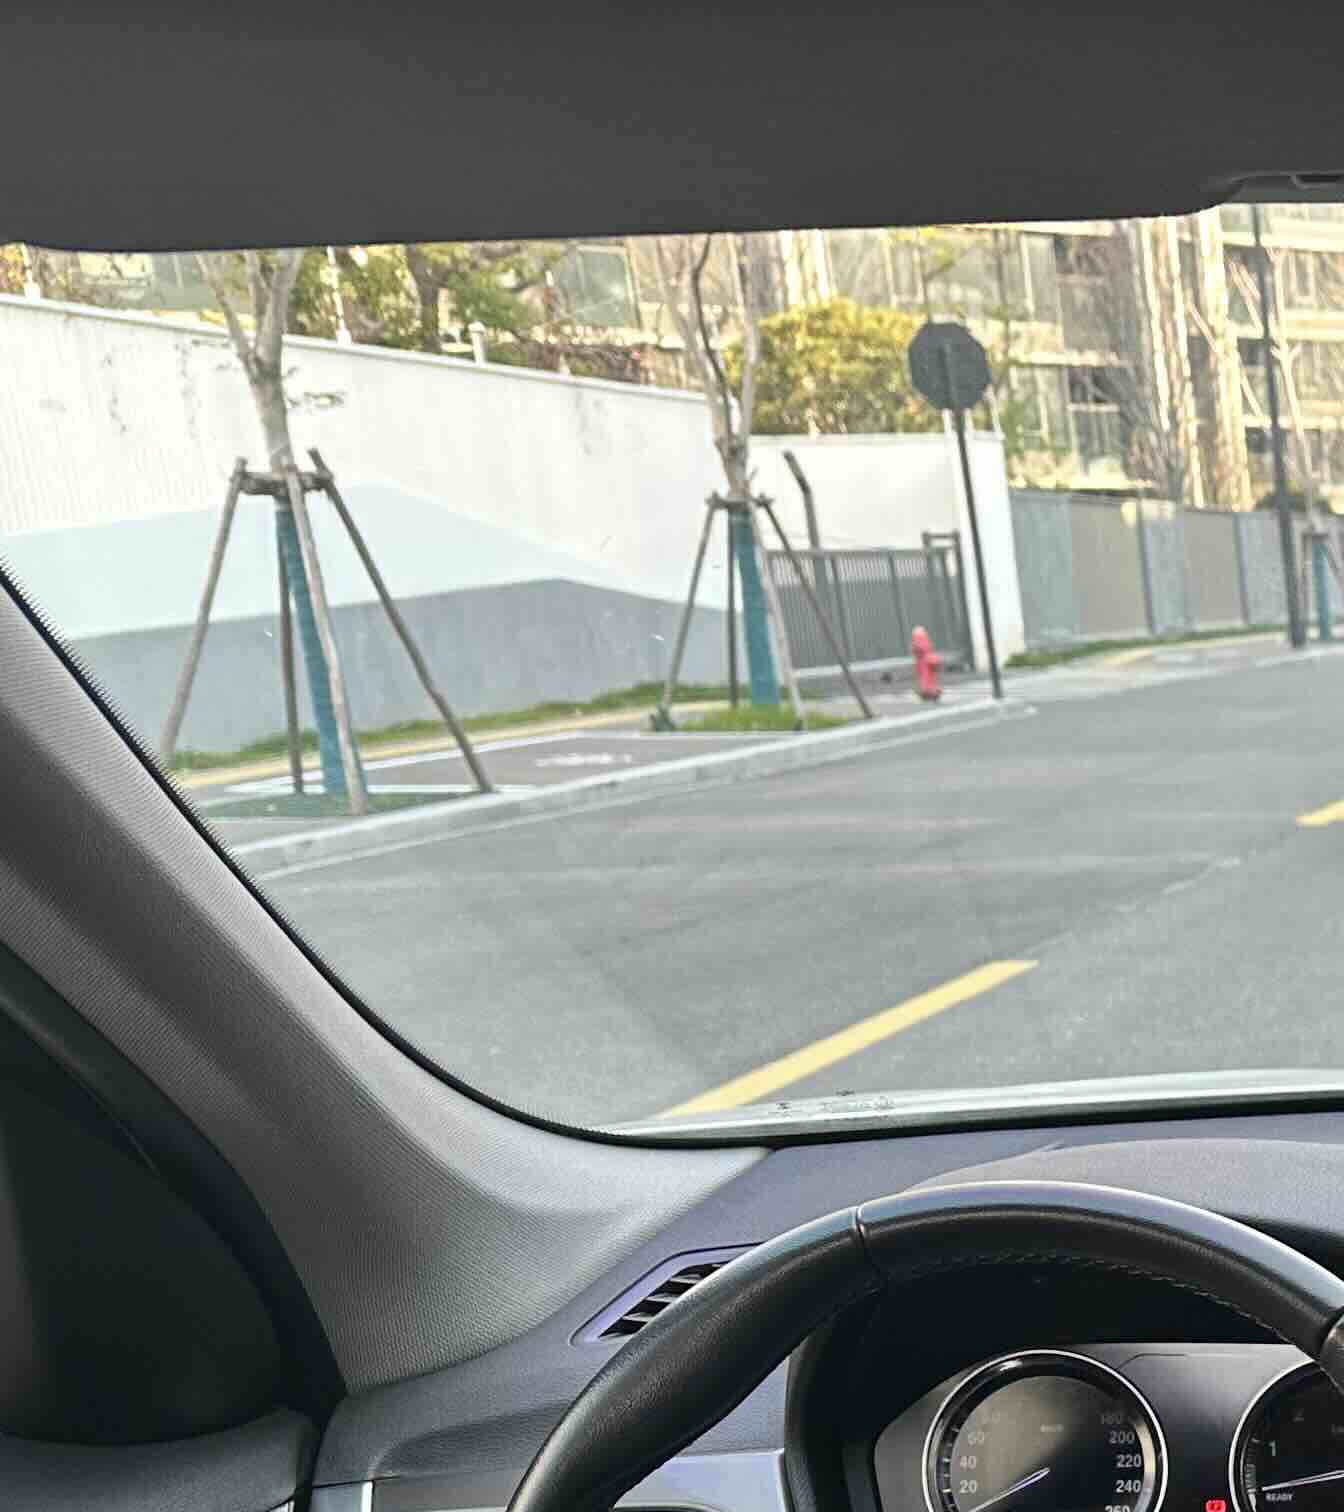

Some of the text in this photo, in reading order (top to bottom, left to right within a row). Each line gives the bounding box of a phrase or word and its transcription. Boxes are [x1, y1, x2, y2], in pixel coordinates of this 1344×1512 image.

[1109, 1431, 1135, 1444] 200
[959, 1456, 977, 1469] 40
[1116, 1455, 1142, 1468] 220
[959, 1480, 978, 1494] 20
[1115, 1480, 1142, 1493] 240
